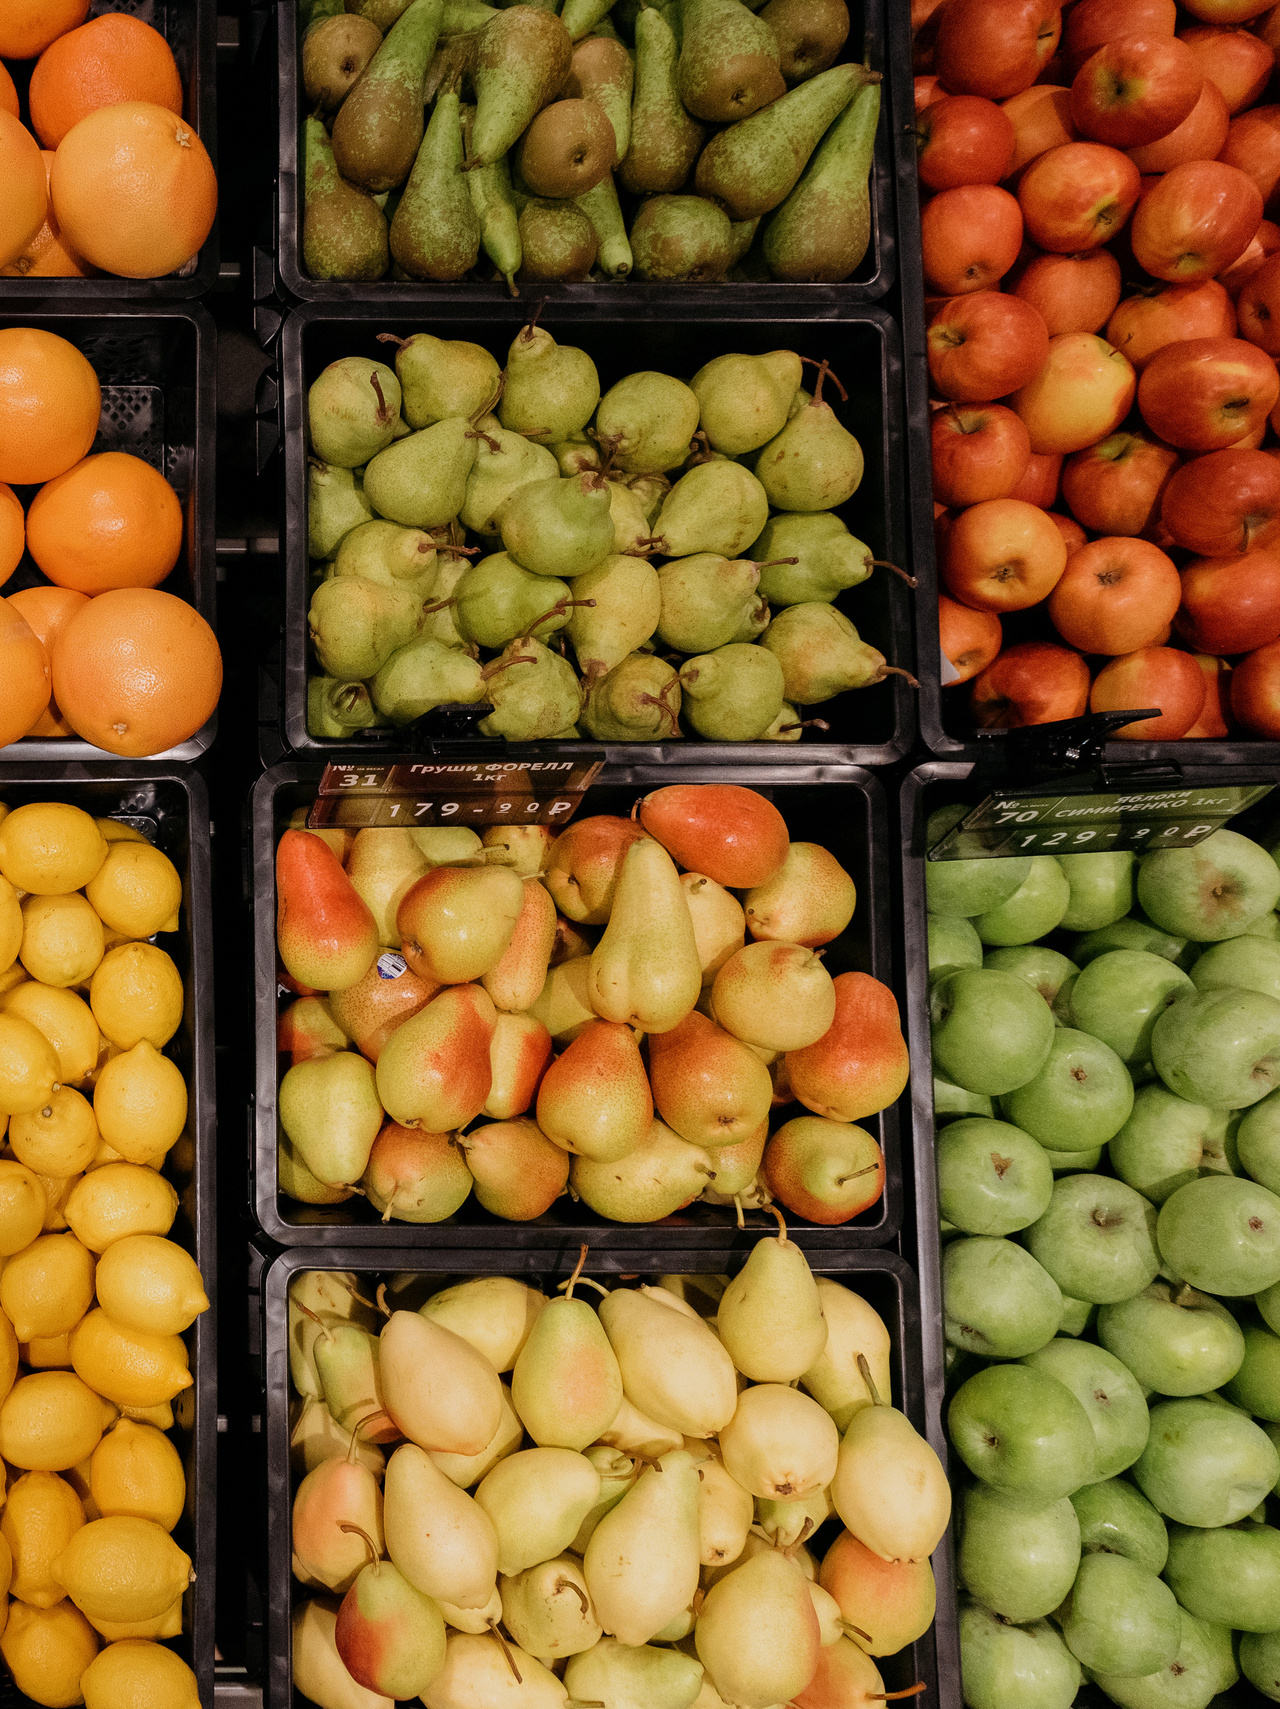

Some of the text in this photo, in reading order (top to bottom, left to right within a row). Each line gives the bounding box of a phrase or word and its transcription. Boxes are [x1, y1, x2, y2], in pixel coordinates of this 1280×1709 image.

[410, 762, 574, 774] Груши ФОРЕЛЛ
[339, 774, 378, 787] 31
[472, 773, 507, 782] 1кг
[1054, 798, 1231, 818] СИМИРЕНКО 1кг
[994, 811, 1039, 824] 70
